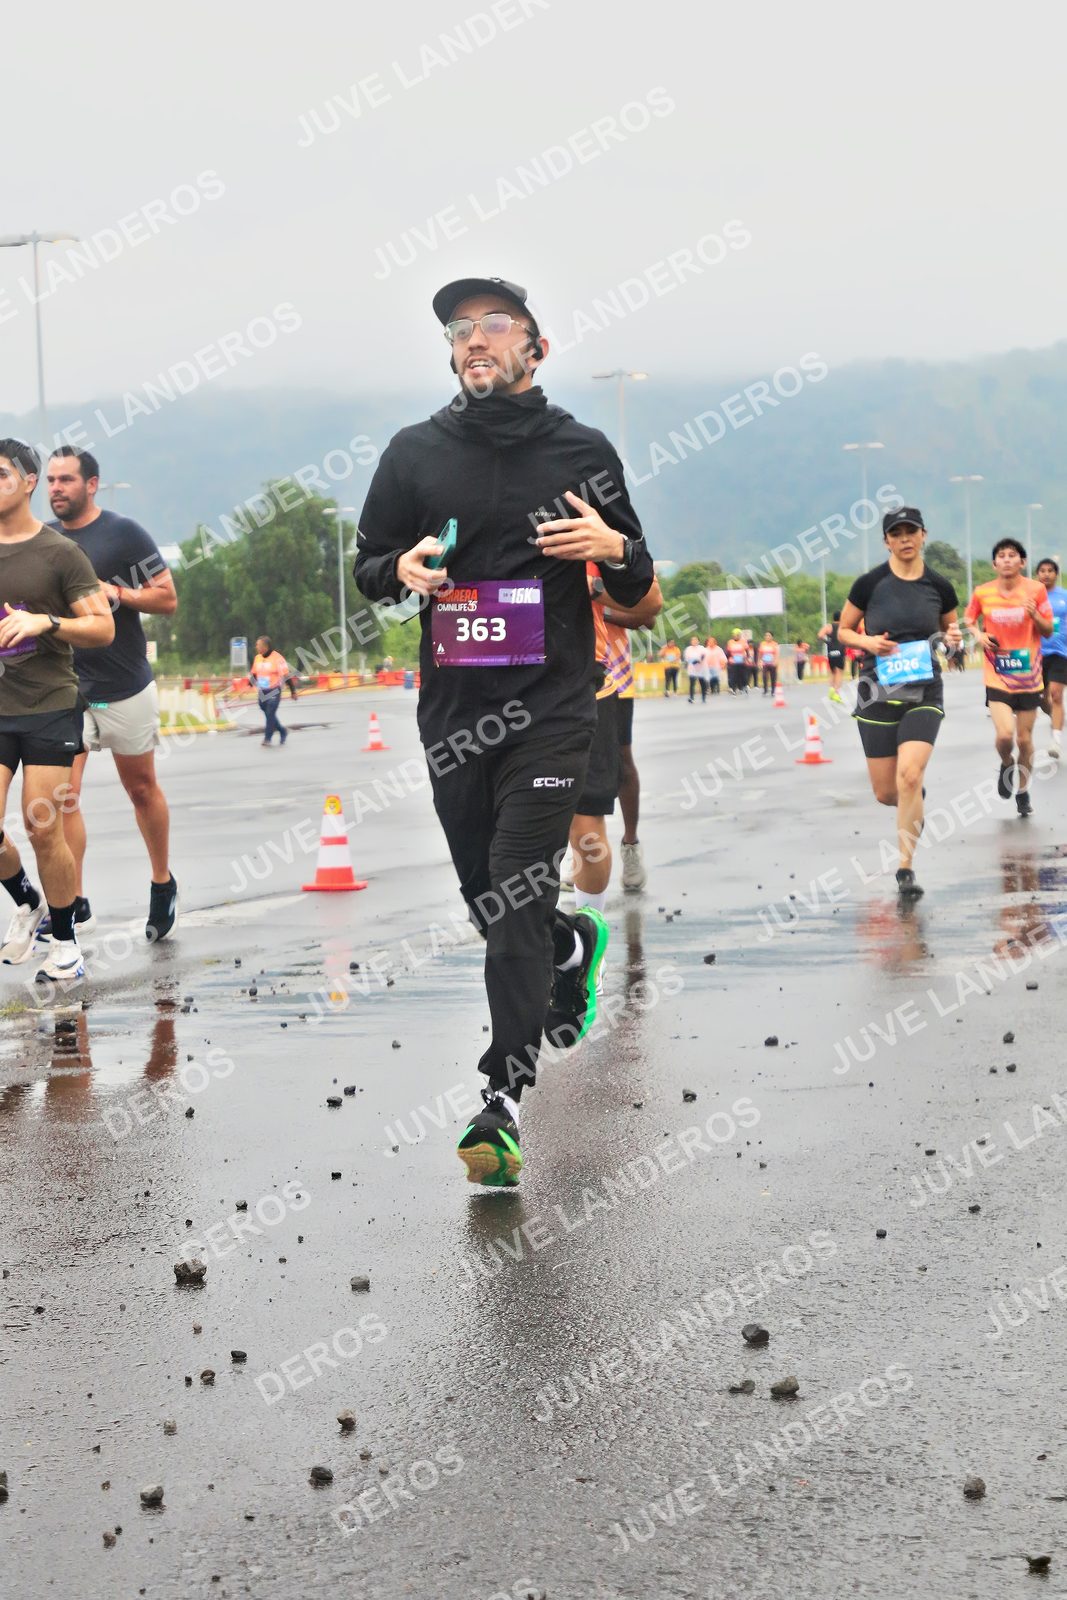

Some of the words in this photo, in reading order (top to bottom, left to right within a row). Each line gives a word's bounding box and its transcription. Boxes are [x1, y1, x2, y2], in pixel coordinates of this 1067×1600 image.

[437, 603, 467, 612] OMNILIFE
[456, 617, 507, 642] 363
[886, 657, 920, 673] 2026
[533, 777, 575, 788] ECHT
